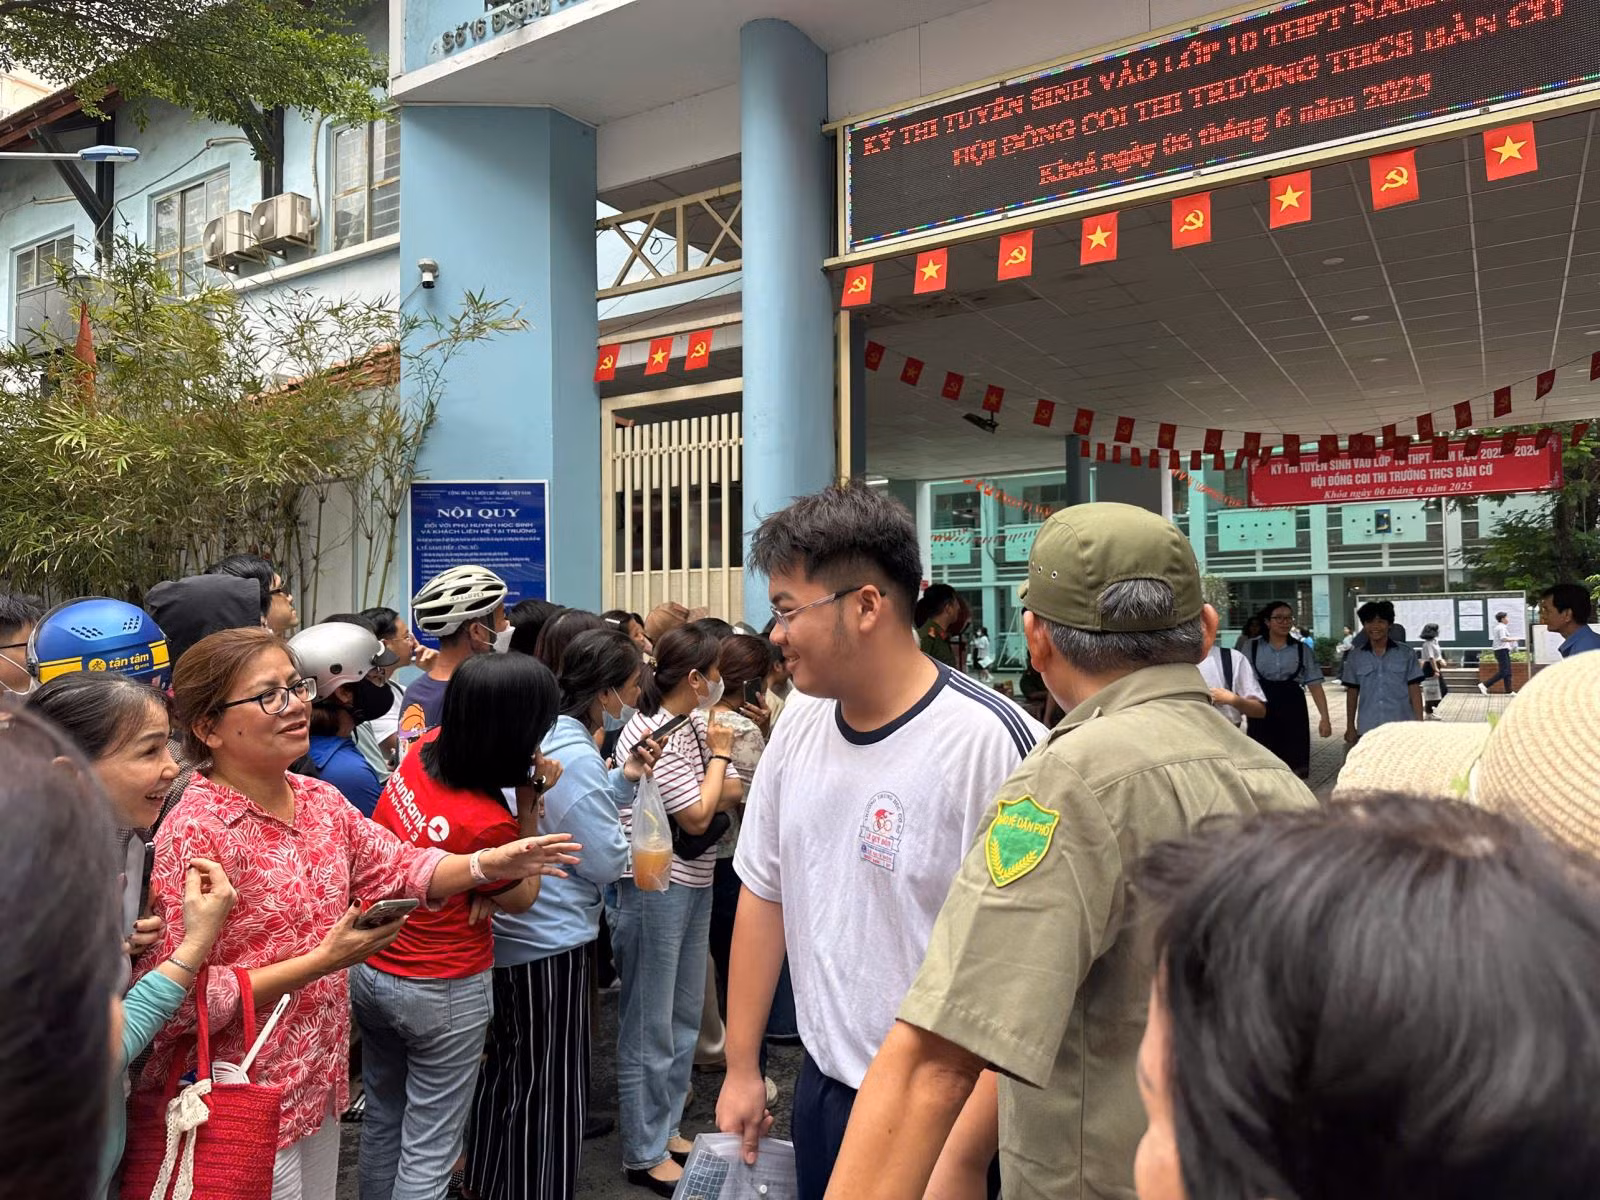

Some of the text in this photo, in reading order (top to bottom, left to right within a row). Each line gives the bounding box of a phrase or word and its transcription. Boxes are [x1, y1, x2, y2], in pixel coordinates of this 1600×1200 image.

[469, 18, 486, 41] 16
[900, 118, 939, 145] THI
[1227, 31, 1259, 55] 10
[1263, 6, 1345, 47] THPT
[1134, 92, 1182, 122] THI
[1326, 30, 1413, 74] THCS
[1275, 106, 1292, 129] 6
[1329, 459, 1351, 471] SINH
[1408, 453, 1430, 465] THPT
[1372, 472, 1387, 483] THI
[1428, 467, 1453, 480] THCS
[1374, 487, 1385, 496] 06
[1416, 484, 1423, 493] 6
[1449, 481, 1473, 491] 2025
[478, 508, 520, 519] QUY
[410, 831, 419, 842] 3
